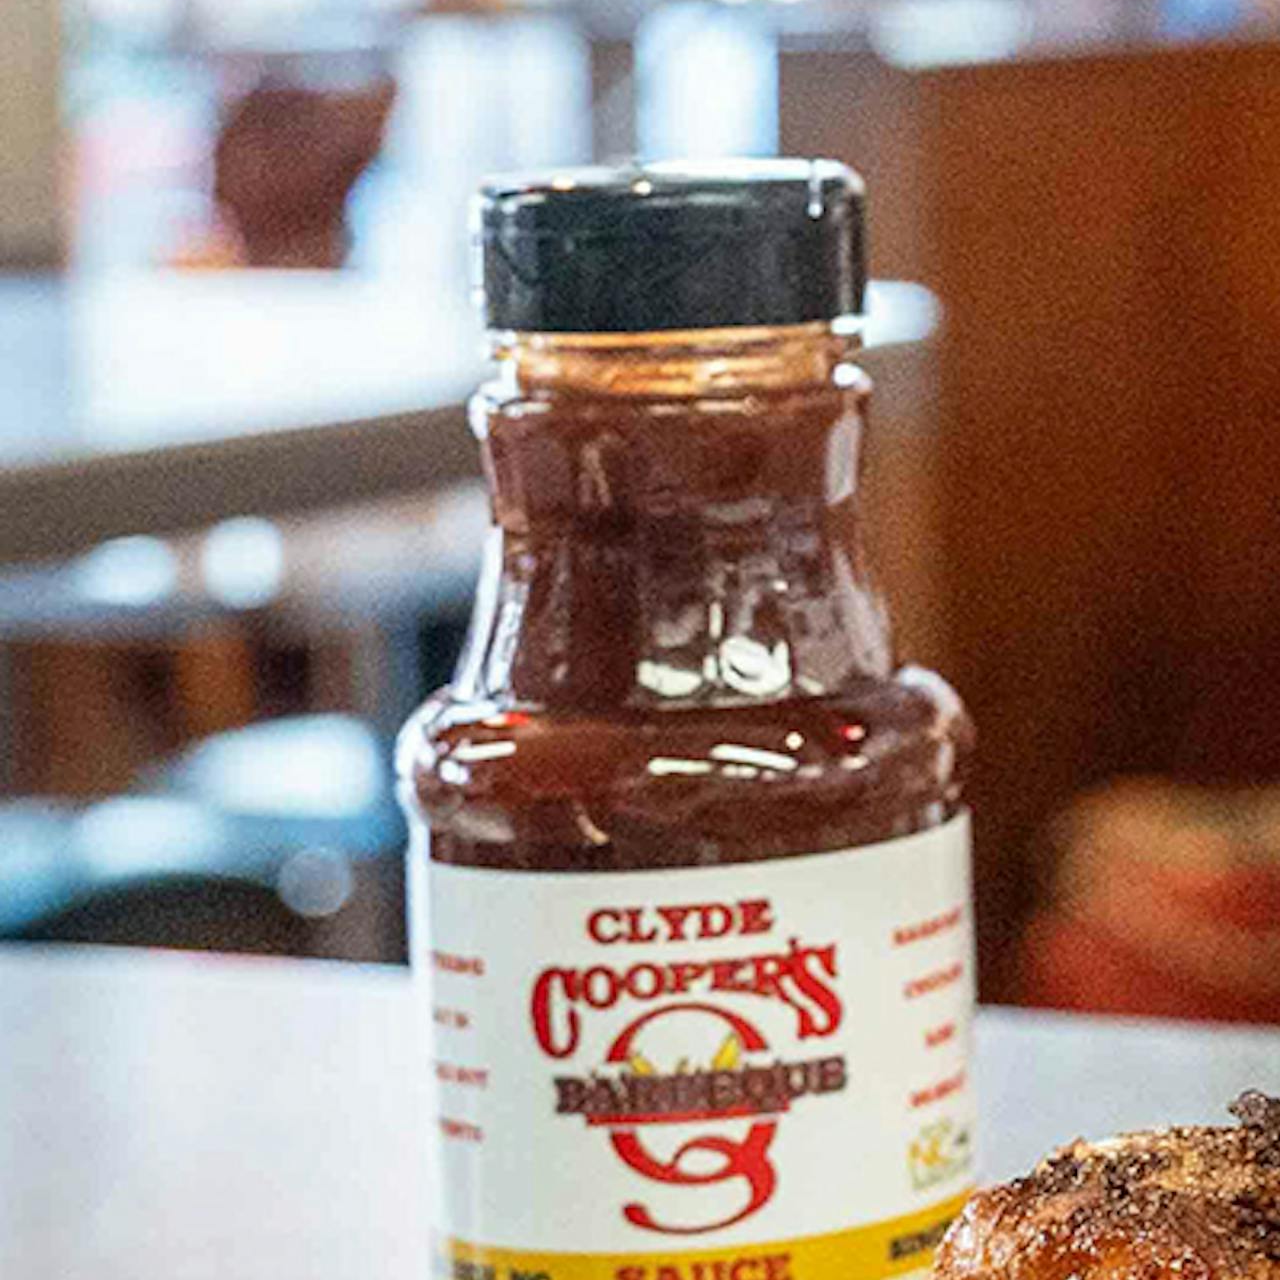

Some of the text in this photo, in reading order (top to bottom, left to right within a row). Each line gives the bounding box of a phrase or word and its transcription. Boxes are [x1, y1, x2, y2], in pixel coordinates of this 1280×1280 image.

[586, 900, 774, 944] CLYDE
[530, 937, 844, 1059] COOPER'S
[554, 1056, 846, 1115] BARBEQUE
